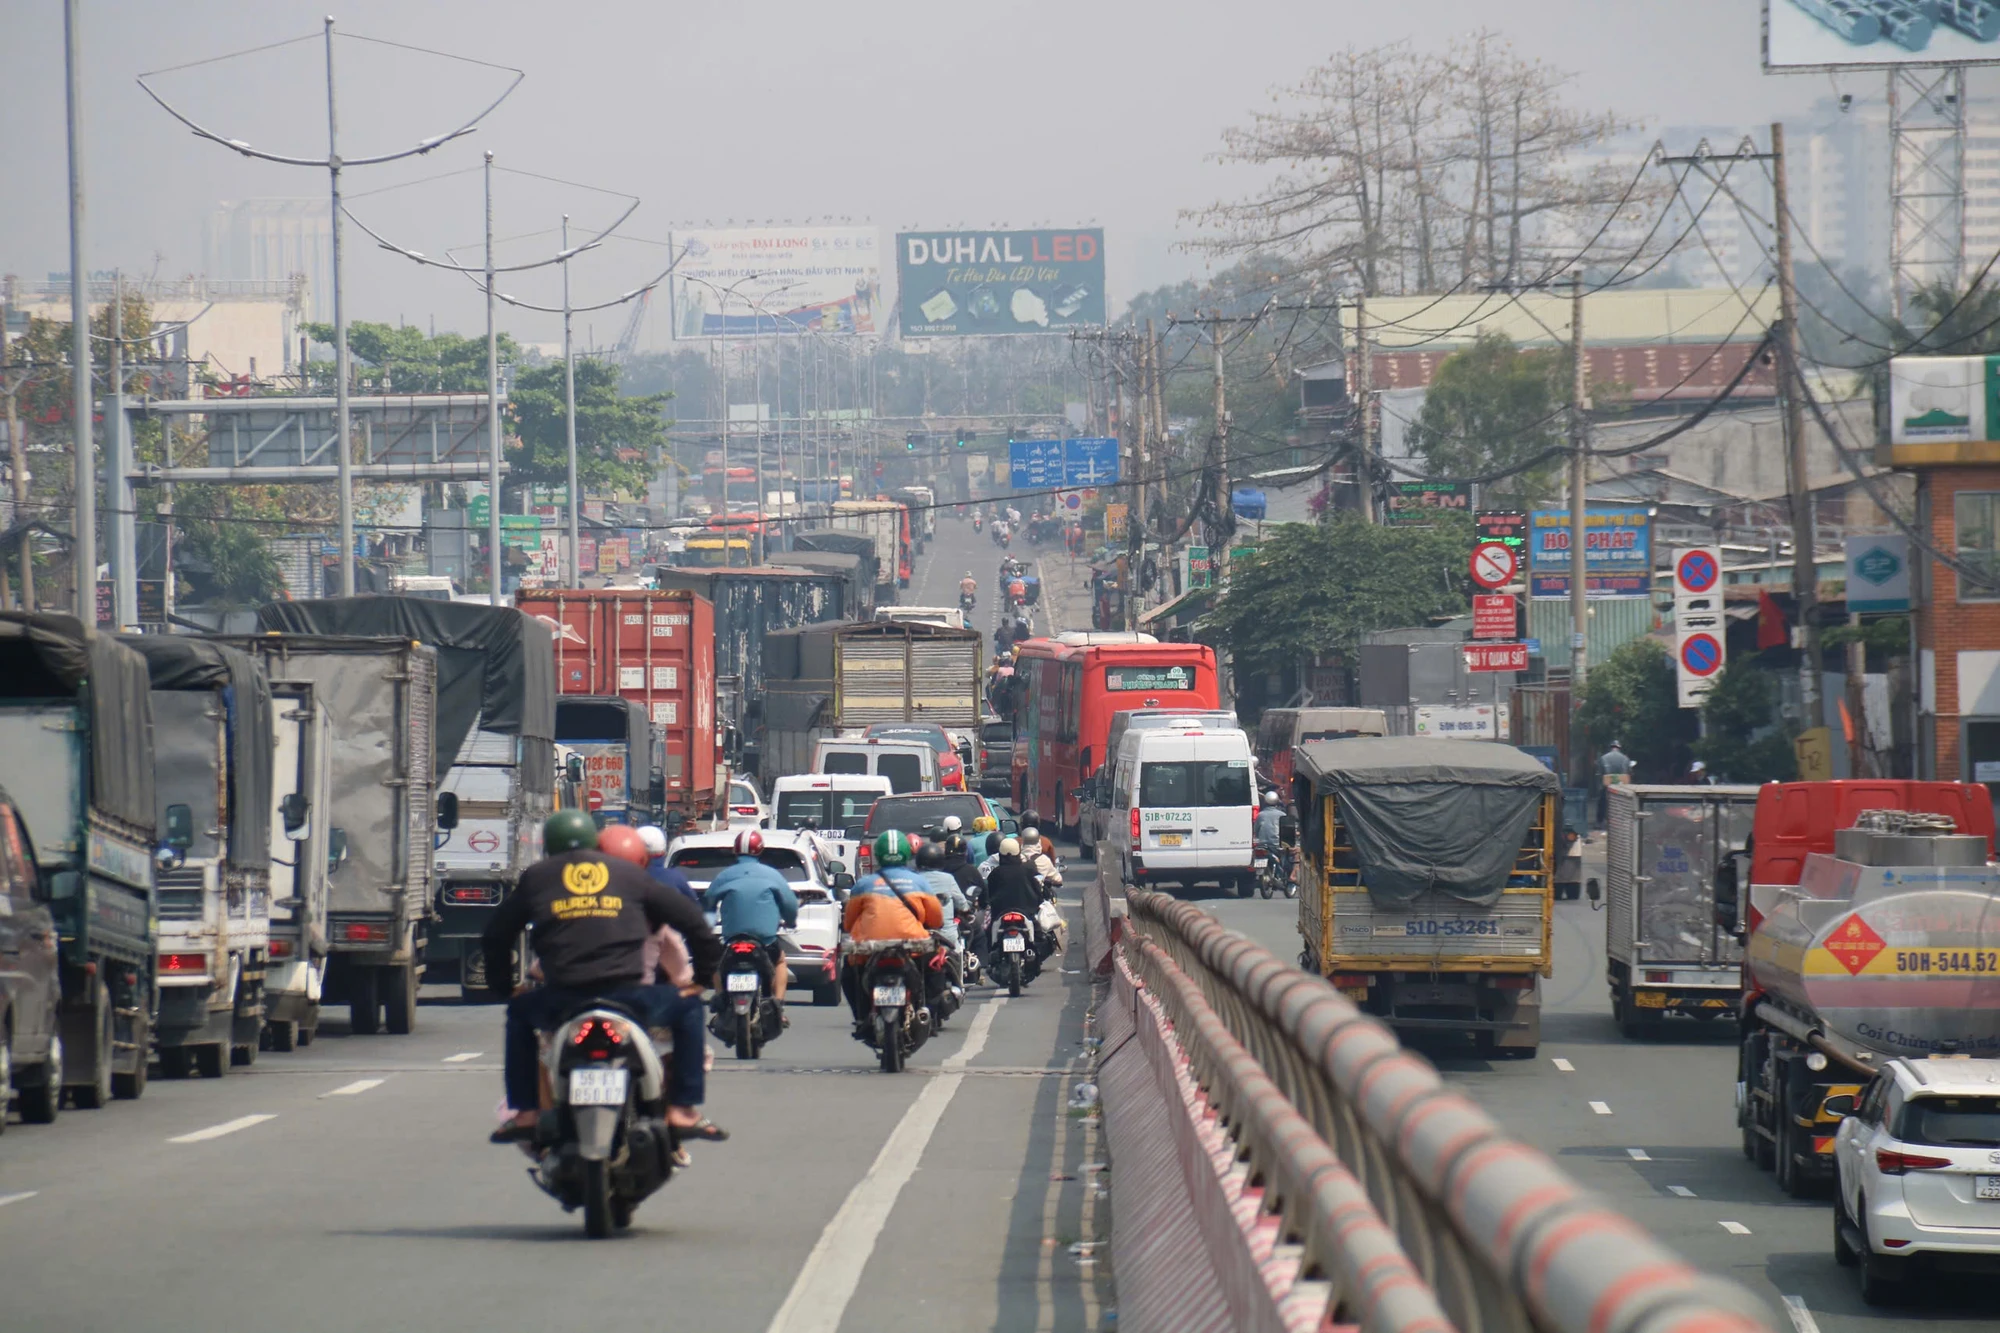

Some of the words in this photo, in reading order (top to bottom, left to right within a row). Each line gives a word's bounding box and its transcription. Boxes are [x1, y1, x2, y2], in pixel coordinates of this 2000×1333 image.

[775, 236, 808, 249] LONG
[907, 236, 1023, 265] DUHAL
[1032, 234, 1097, 262] LED
[844, 266, 864, 275] NAM
[1009, 265, 1034, 282] LED
[654, 627, 672, 636] 45G1
[1488, 651, 1510, 666] QUAN
[604, 775, 621, 788] 734
[1406, 920, 1499, 936] 51D-53261
[1850, 955, 1859, 966] 3
[1896, 952, 1998, 972] 50H-544.52
[1857, 1022, 1883, 1040] Coi
